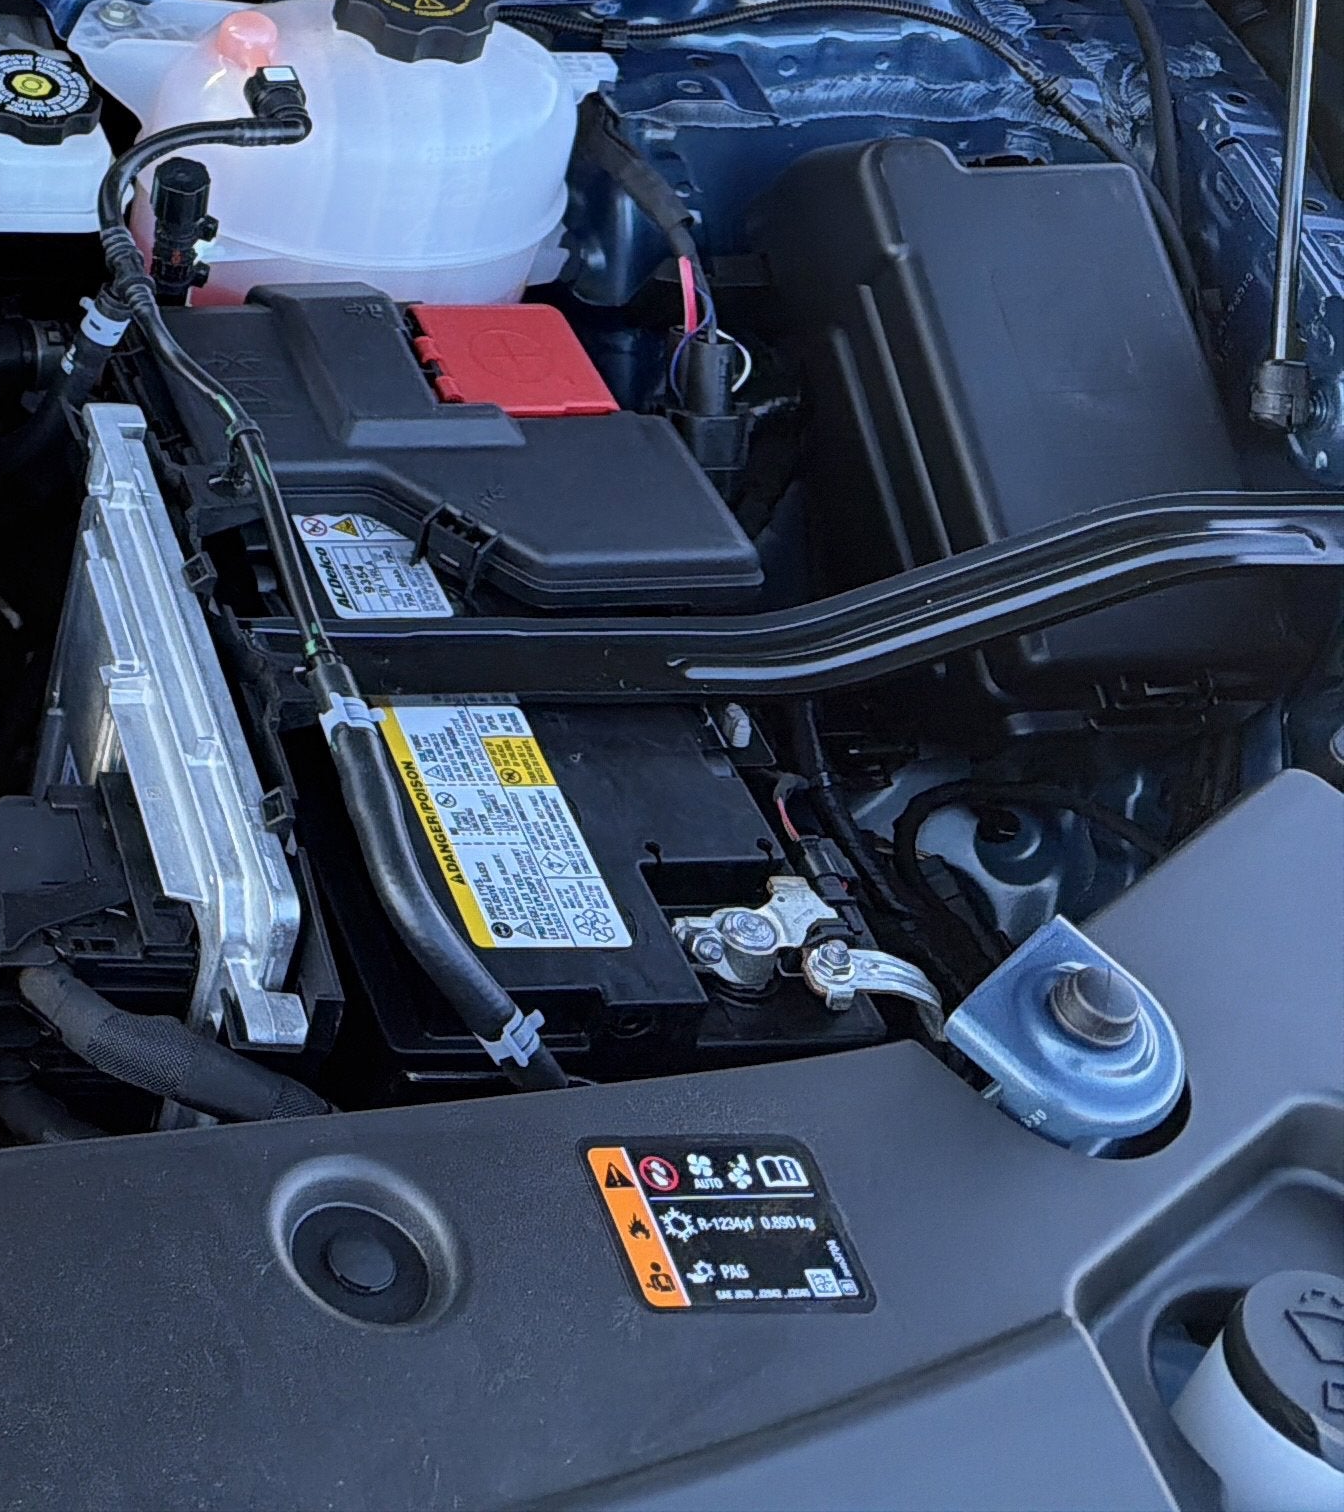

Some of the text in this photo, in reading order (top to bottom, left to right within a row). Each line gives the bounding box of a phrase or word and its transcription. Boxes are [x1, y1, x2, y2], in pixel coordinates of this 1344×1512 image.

[315, 546, 354, 609] ACDelco
[352, 565, 376, 593] 9354
[400, 761, 460, 872] DANGER/POISON
[693, 1178, 724, 1189] AUTO
[697, 1214, 816, 1232] R-1234yf 0.890 kg
[719, 1263, 750, 1280] PAG
